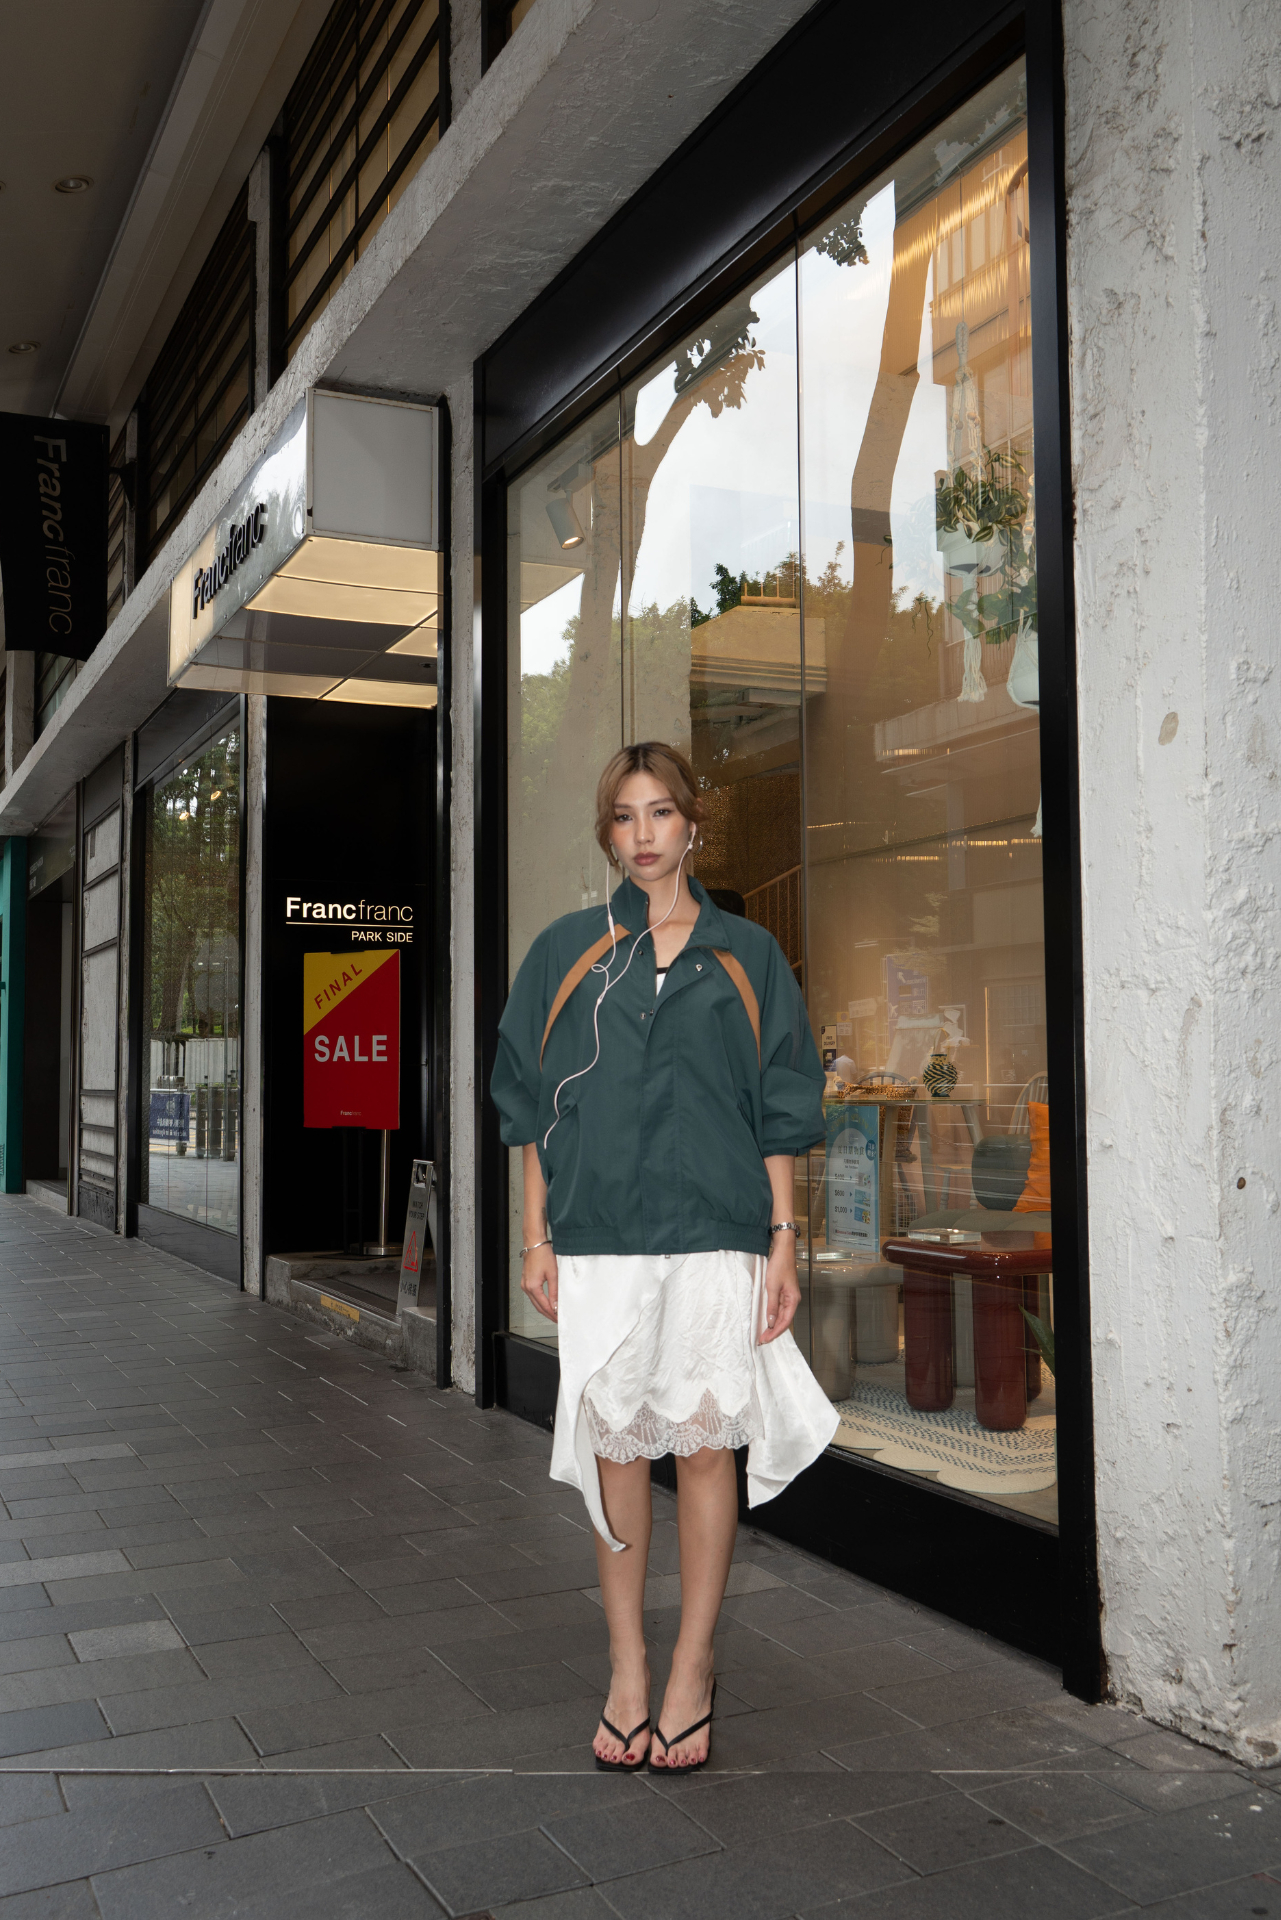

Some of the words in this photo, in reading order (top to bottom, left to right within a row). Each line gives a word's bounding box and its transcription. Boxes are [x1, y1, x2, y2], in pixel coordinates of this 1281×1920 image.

[33, 435, 75, 634] Francfranc
[192, 503, 266, 619] Francfranc
[286, 896, 413, 921] Francfranc
[351, 931, 383, 942] PARK
[386, 932, 413, 943] SIDE
[314, 964, 363, 1010] FINAL
[314, 1035, 388, 1062] SALE
